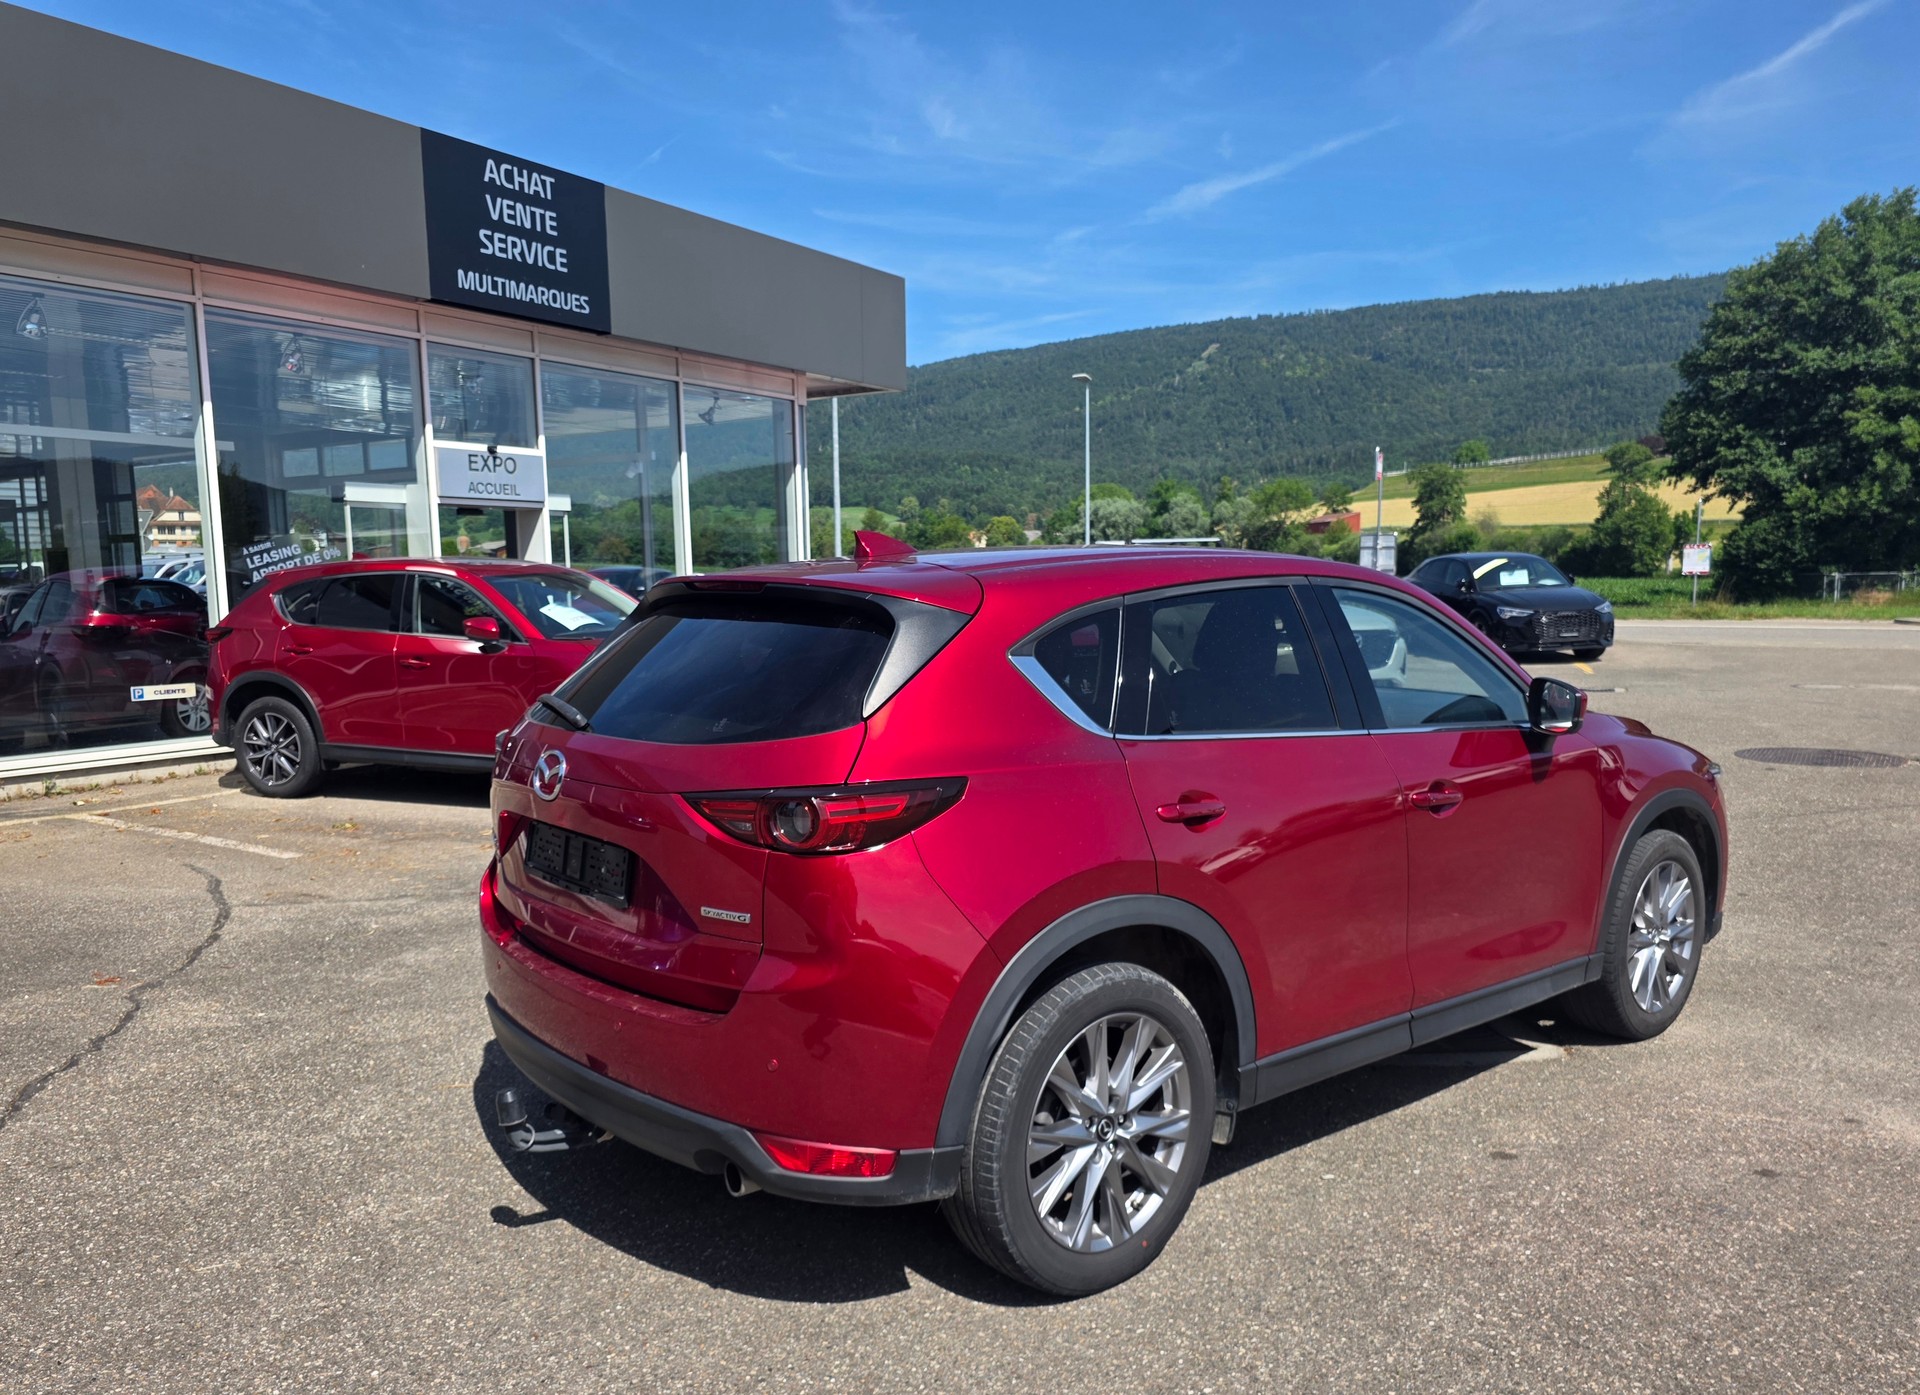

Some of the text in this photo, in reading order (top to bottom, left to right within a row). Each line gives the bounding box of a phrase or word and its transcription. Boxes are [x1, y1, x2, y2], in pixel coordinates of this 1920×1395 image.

[483, 158, 555, 200] ACHAT
[485, 193, 558, 236] VENTE
[478, 228, 568, 273] SERVICE
[457, 268, 590, 314] MULTIMARQUES
[468, 453, 517, 474] EXPO
[468, 482, 521, 496] ACCUEIL
[246, 544, 302, 569] LEASING
[304, 552, 322, 565] DE
[323, 547, 341, 560] 0%
